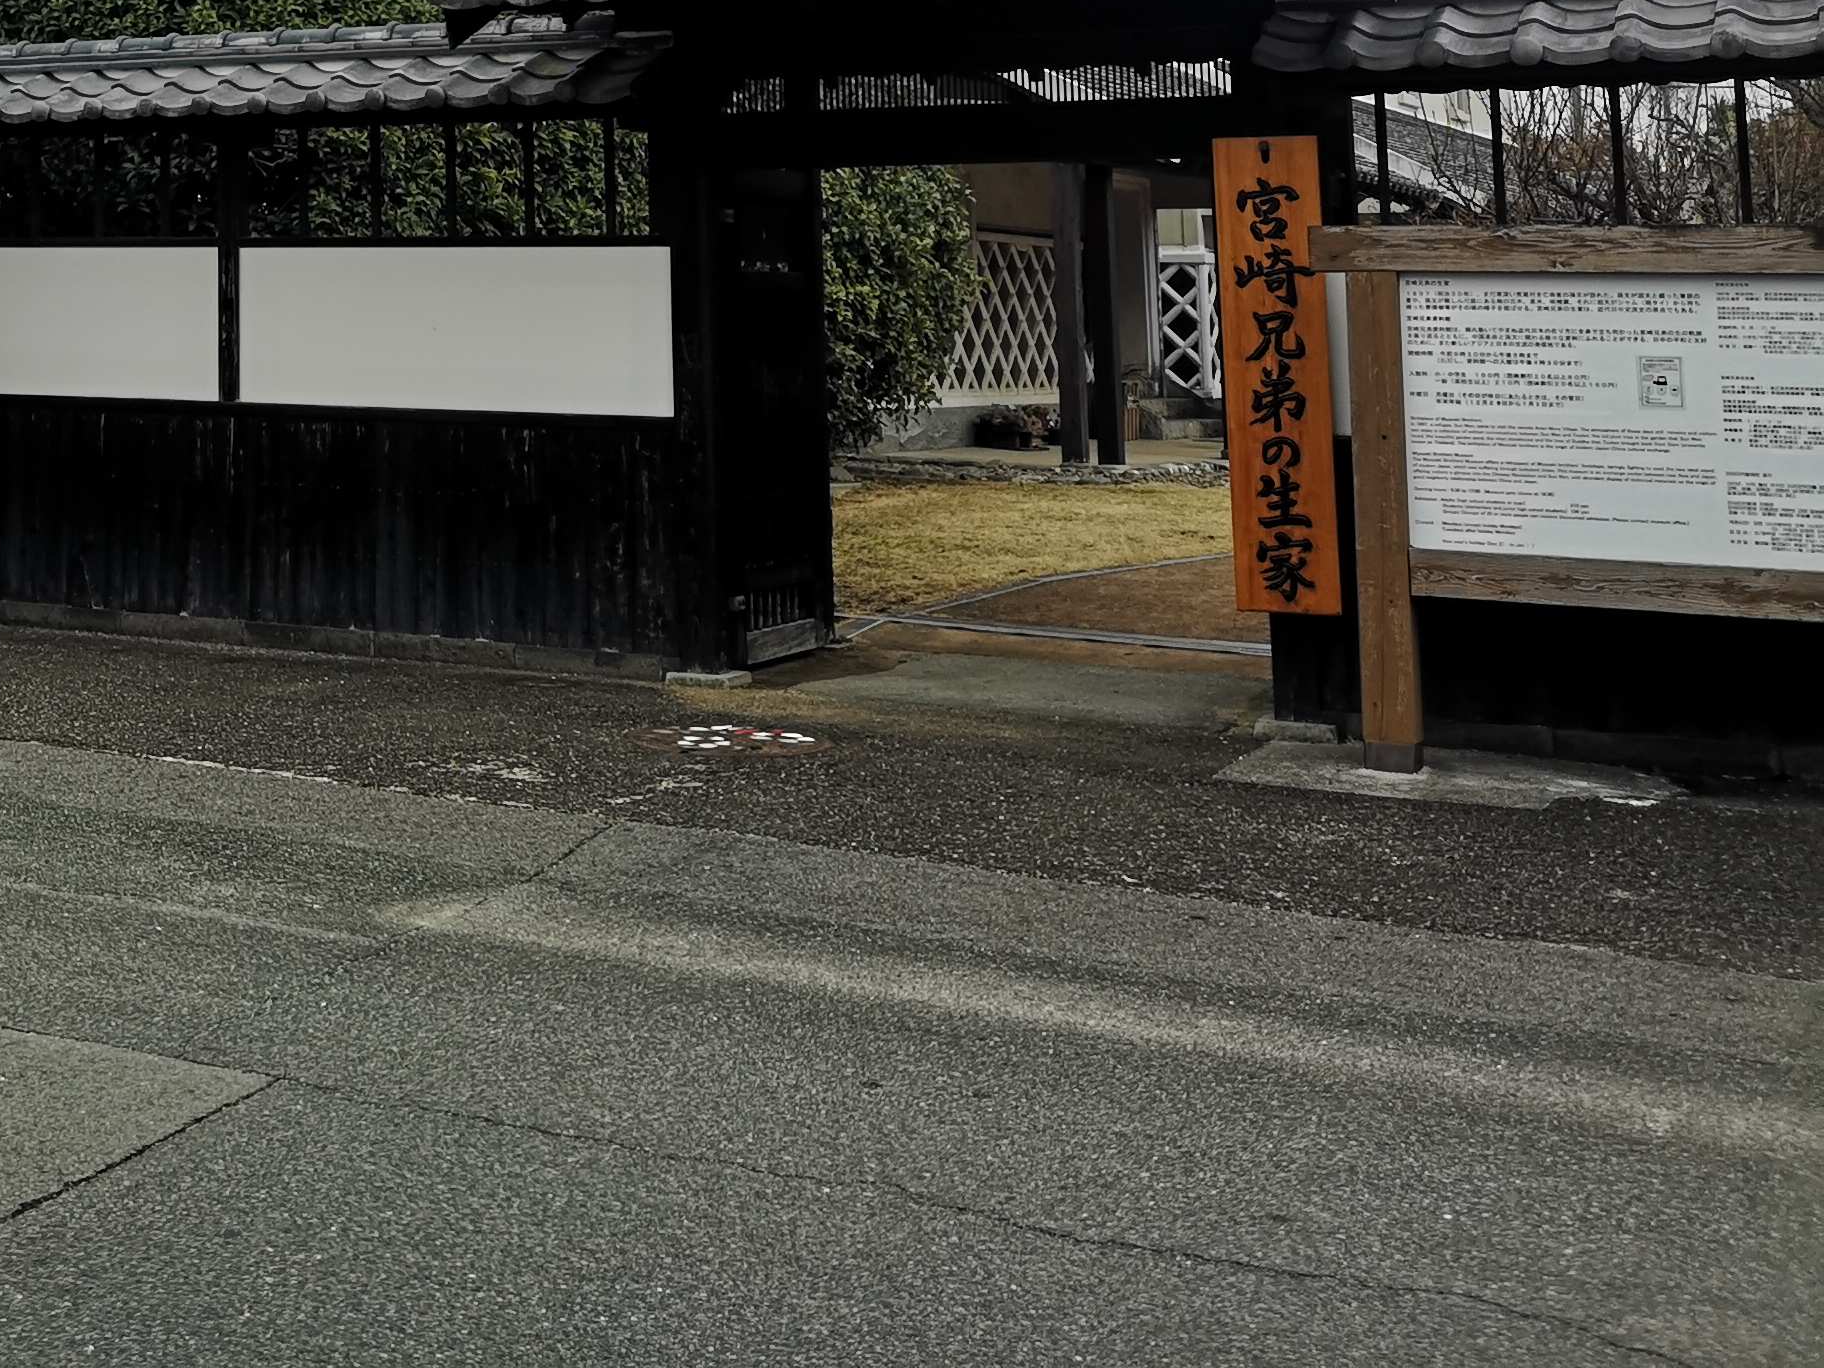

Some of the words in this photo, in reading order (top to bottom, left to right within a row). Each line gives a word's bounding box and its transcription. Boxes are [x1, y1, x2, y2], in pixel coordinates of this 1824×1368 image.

[1233, 177, 1316, 603] 宮崎兄弟の生家
